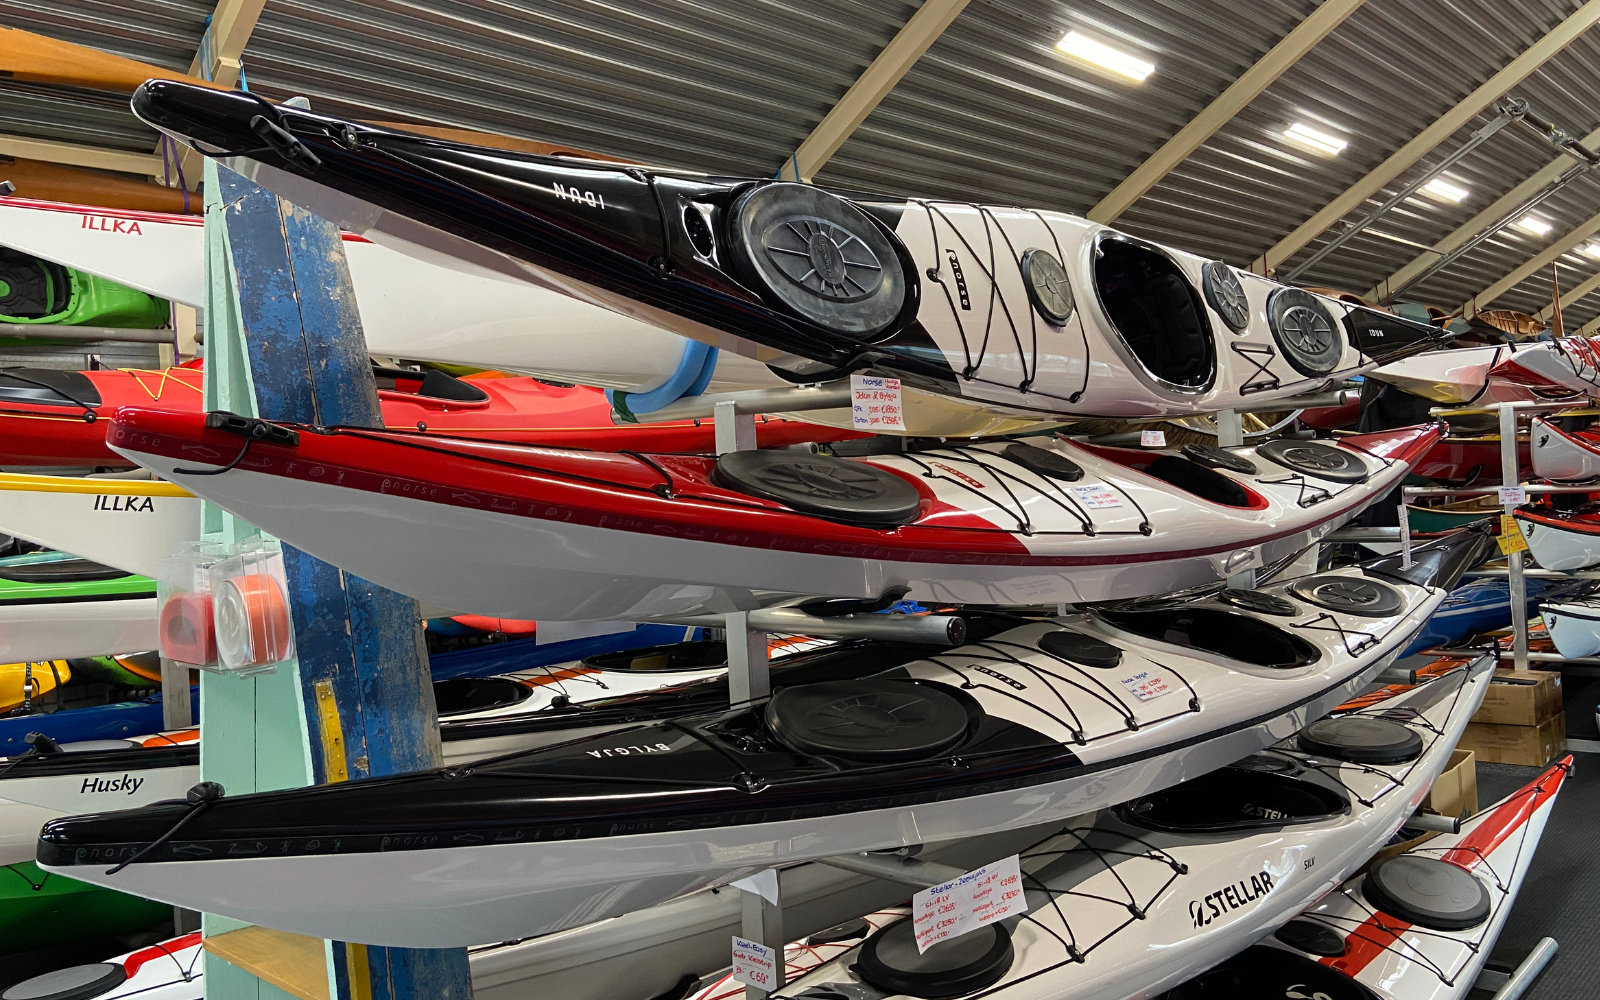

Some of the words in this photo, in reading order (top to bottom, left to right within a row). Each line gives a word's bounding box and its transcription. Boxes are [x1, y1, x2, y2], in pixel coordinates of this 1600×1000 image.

[553, 182, 605, 209] IDUN
[81, 215, 143, 236] ILLKA
[1368, 328, 1385, 338] IDUN
[93, 495, 155, 513] ILLKA
[585, 743, 671, 759] BYLGJA
[80, 773, 144, 796] Husky
[90, 846, 138, 858] nors
[1204, 871, 1275, 919] STELLAR
